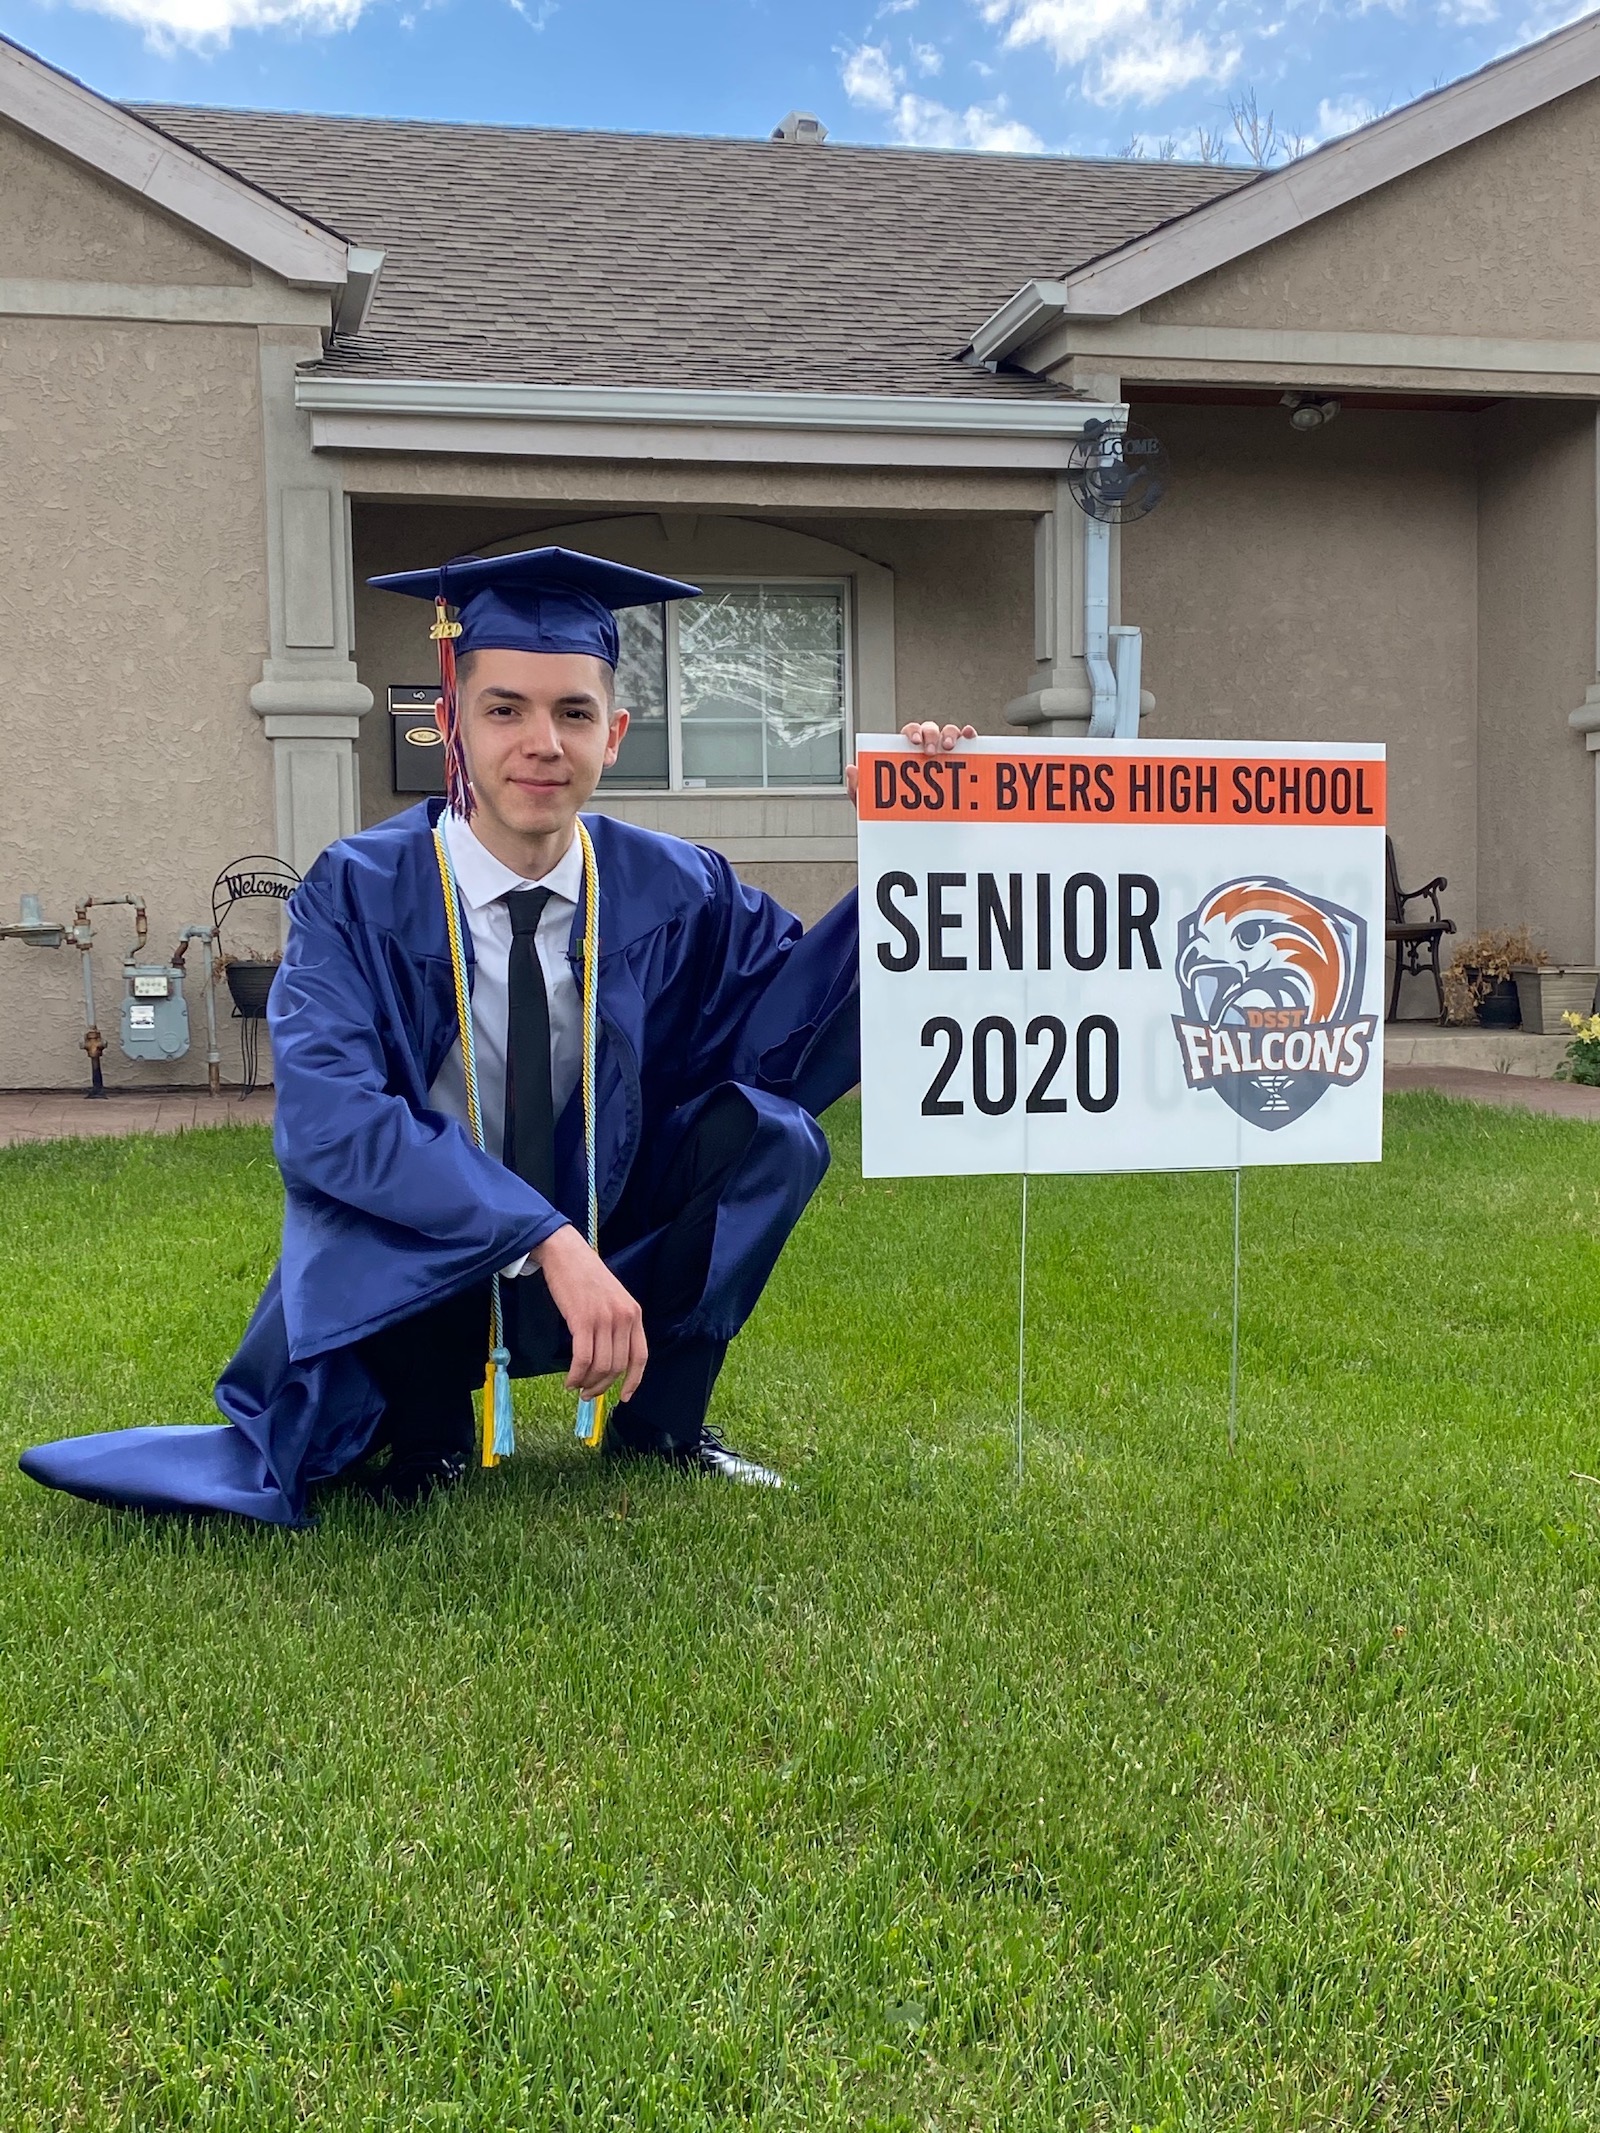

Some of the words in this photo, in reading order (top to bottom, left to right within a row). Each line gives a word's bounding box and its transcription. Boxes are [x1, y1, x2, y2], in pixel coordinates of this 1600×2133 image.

[1078, 438, 1160, 457] WELCOME
[874, 760, 979, 810] DSST:
[996, 762, 1115, 813] BYERS
[1129, 764, 1217, 813] HIGH
[1232, 766, 1374, 816] SCHOOL
[876, 870, 1162, 973] SENIOR
[1247, 1009, 1306, 1029] DSST
[920, 1014, 1120, 1116] 2020
[1180, 1021, 1371, 1081] FALCONS
